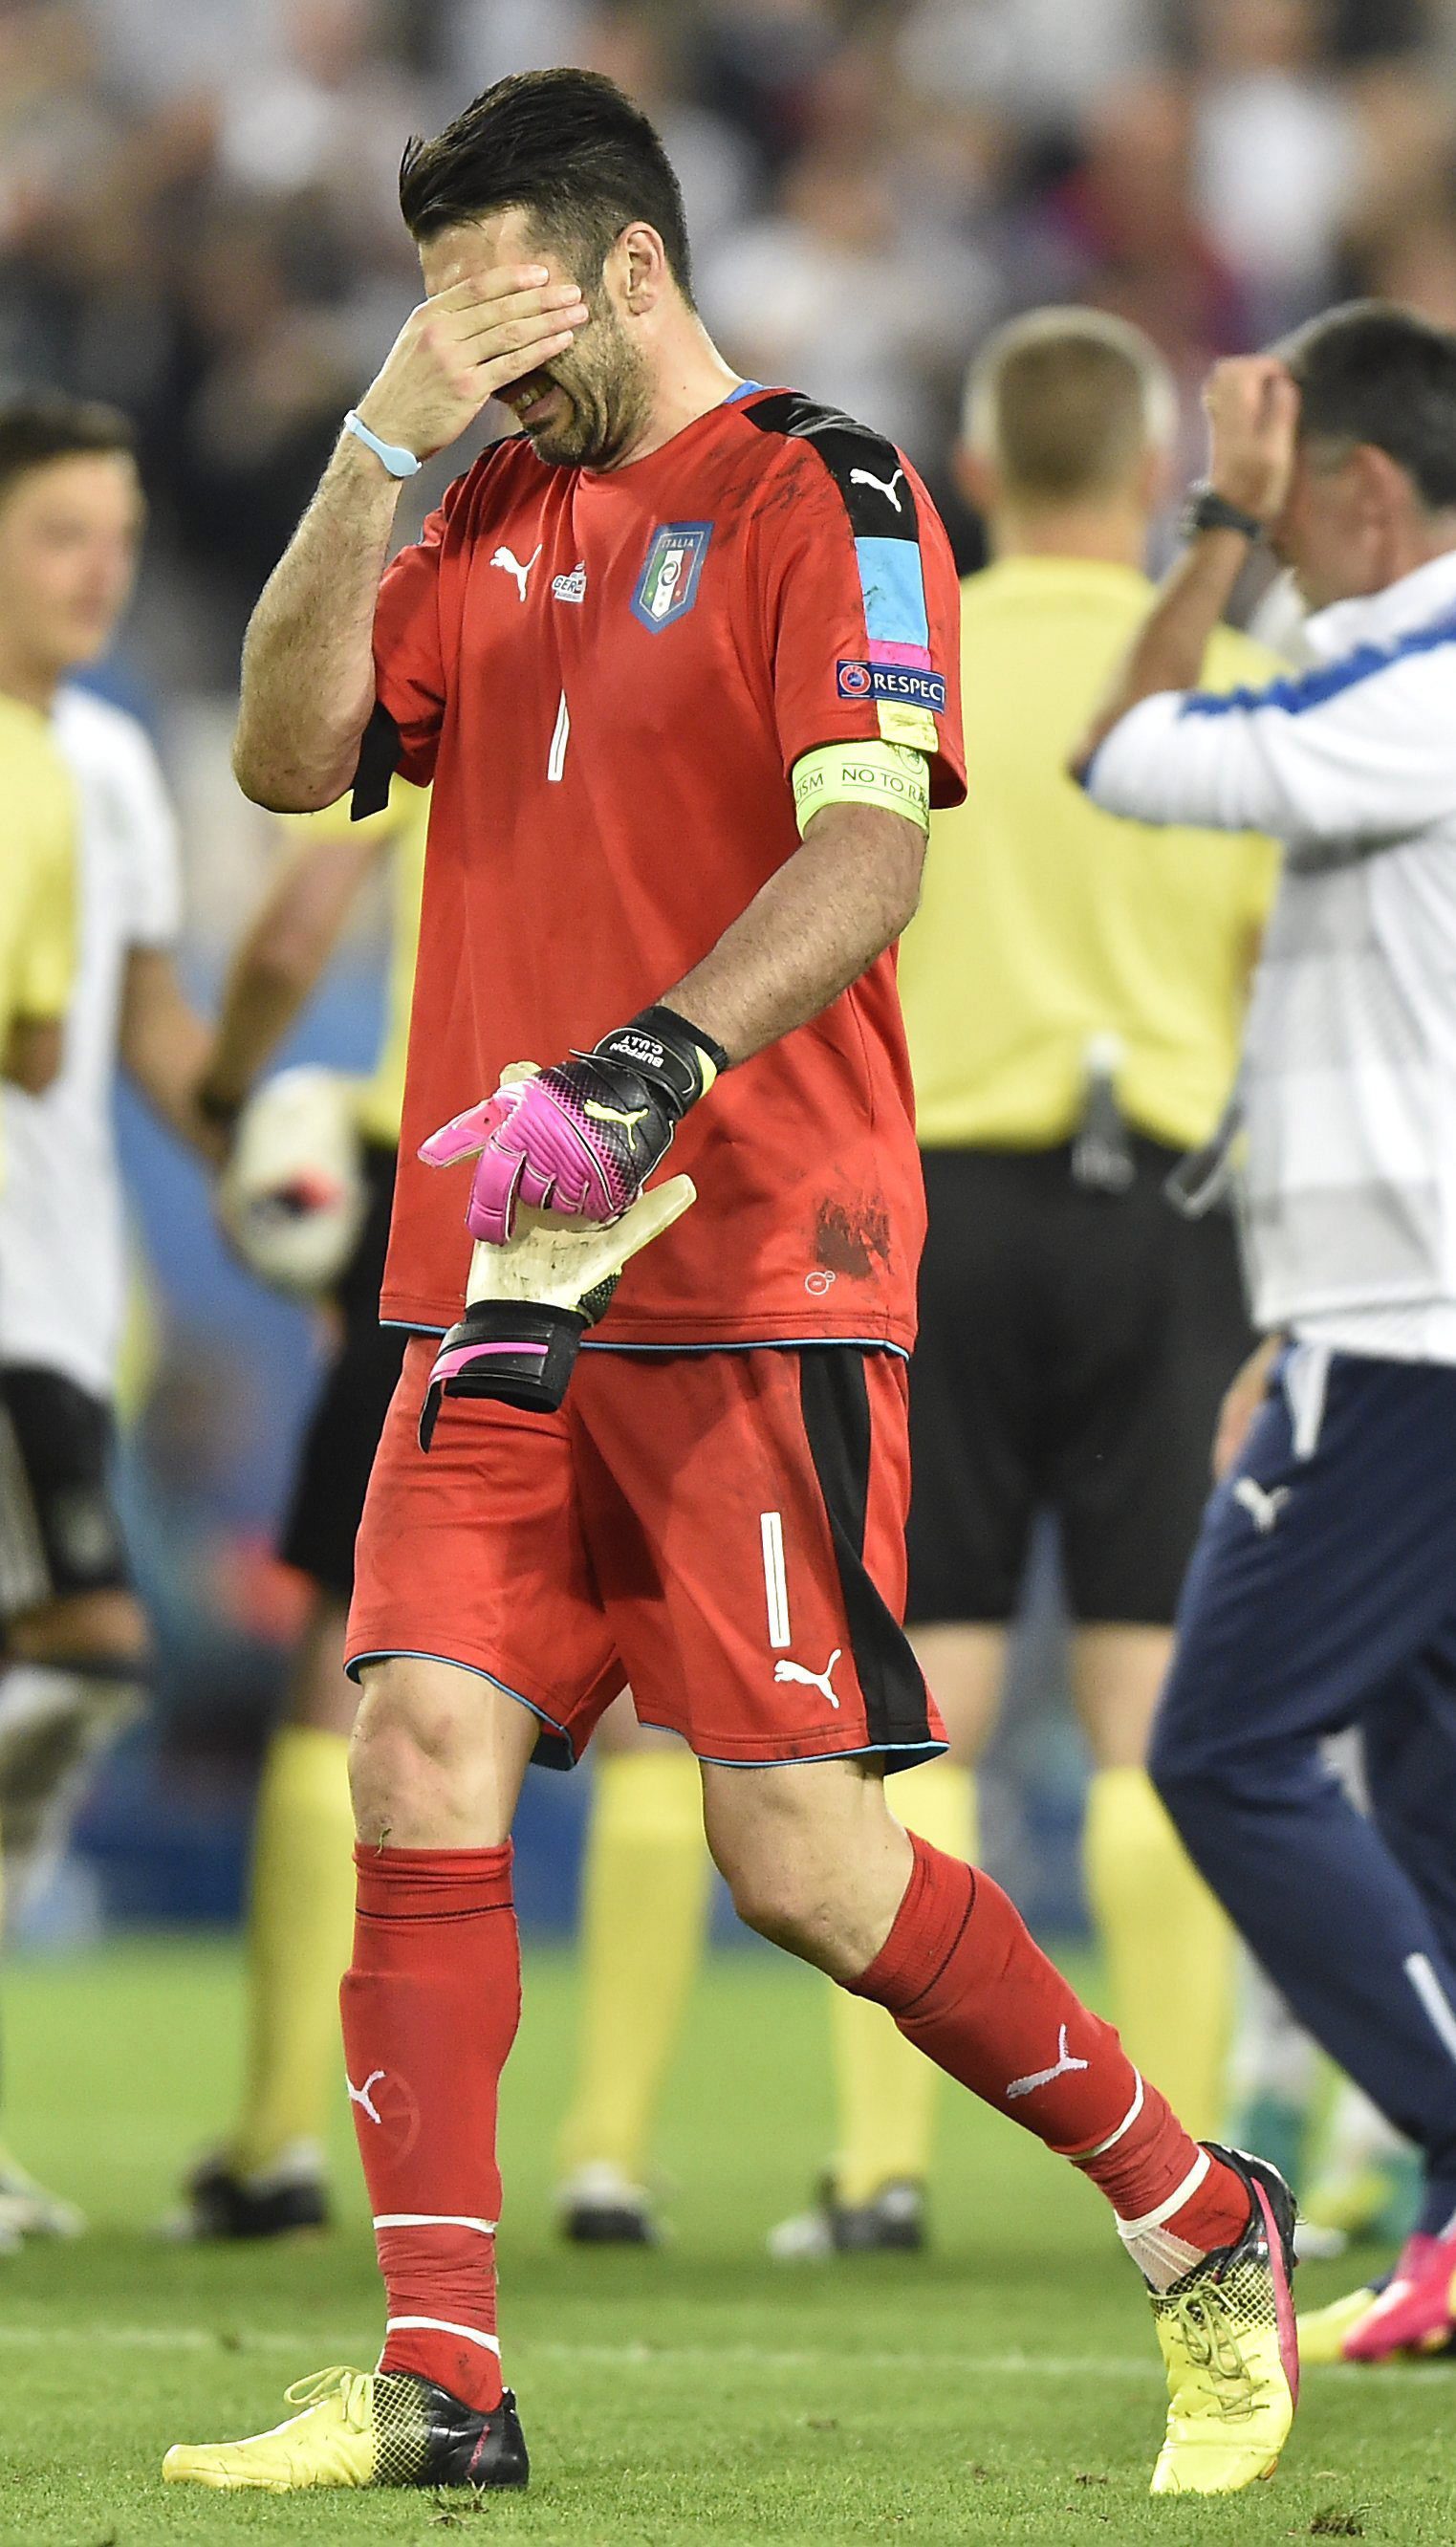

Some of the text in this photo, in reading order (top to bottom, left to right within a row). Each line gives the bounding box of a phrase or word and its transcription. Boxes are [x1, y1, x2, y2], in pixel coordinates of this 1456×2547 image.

[662, 538, 694, 548] ITALIA
[874, 673, 945, 704] RESPECT
[547, 687, 571, 781] 1
[842, 769, 874, 782] NO
[880, 773, 903, 792] TO
[609, 1042, 664, 1068] BUFFON
[760, 1512, 791, 1648] 1
